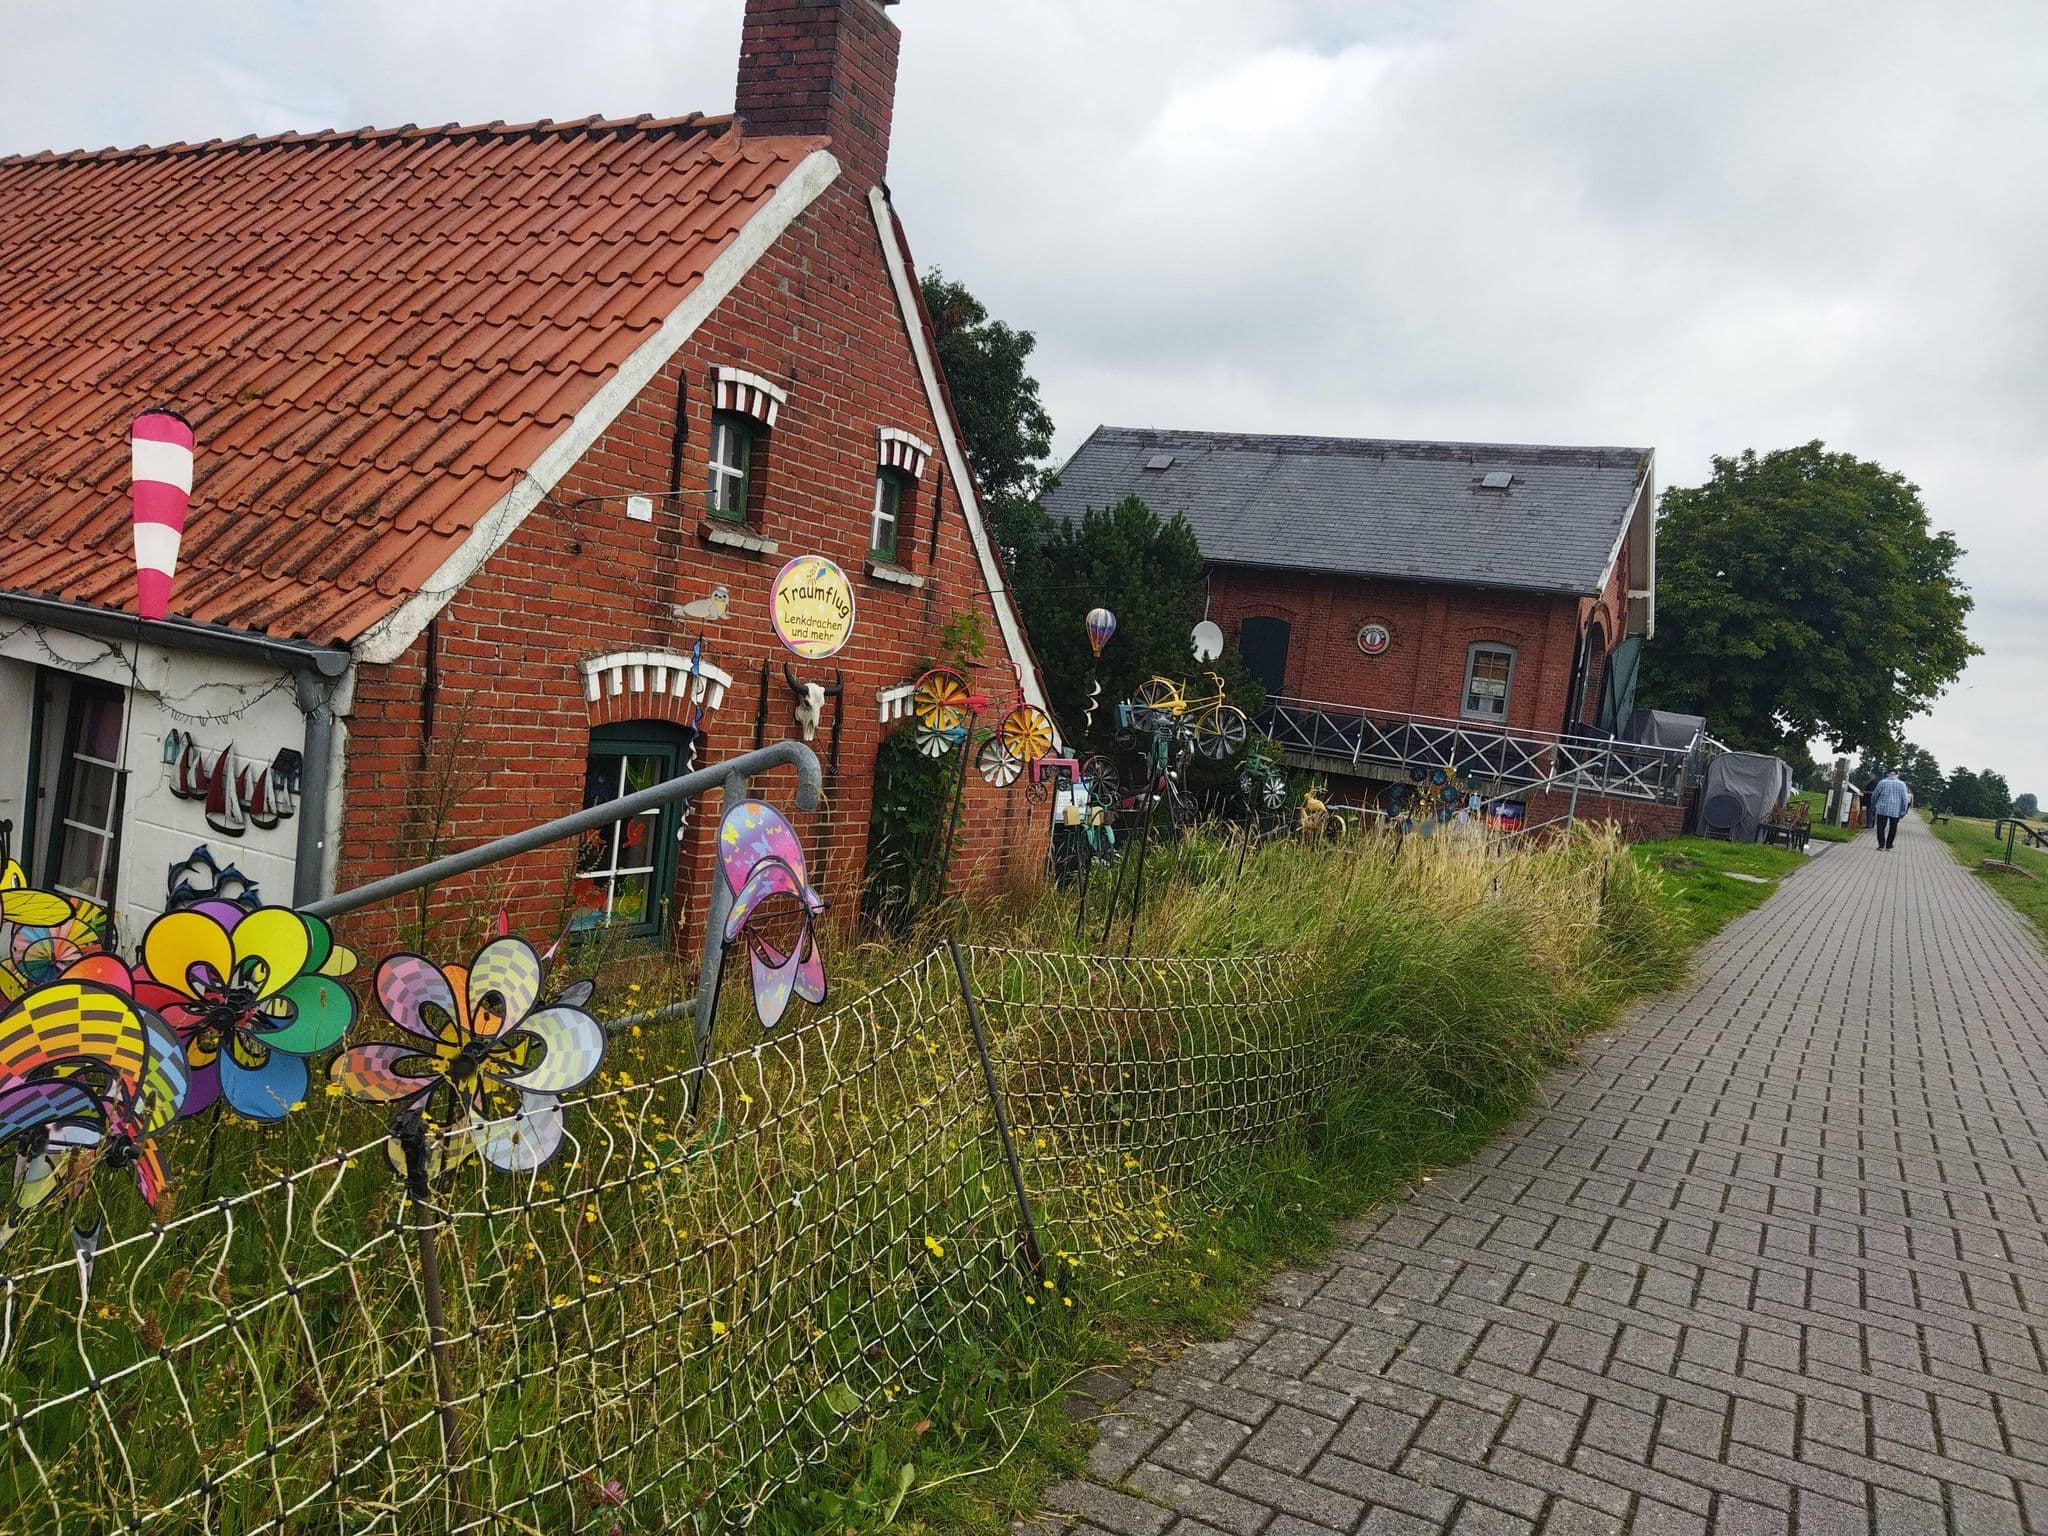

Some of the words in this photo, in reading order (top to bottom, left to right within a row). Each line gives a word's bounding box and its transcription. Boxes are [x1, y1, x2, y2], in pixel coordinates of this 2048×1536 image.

[779, 586, 849, 619] Traumflug
[784, 612, 842, 631] Lenkdrachen
[791, 628, 808, 638] und
[811, 631, 834, 641] mehr
